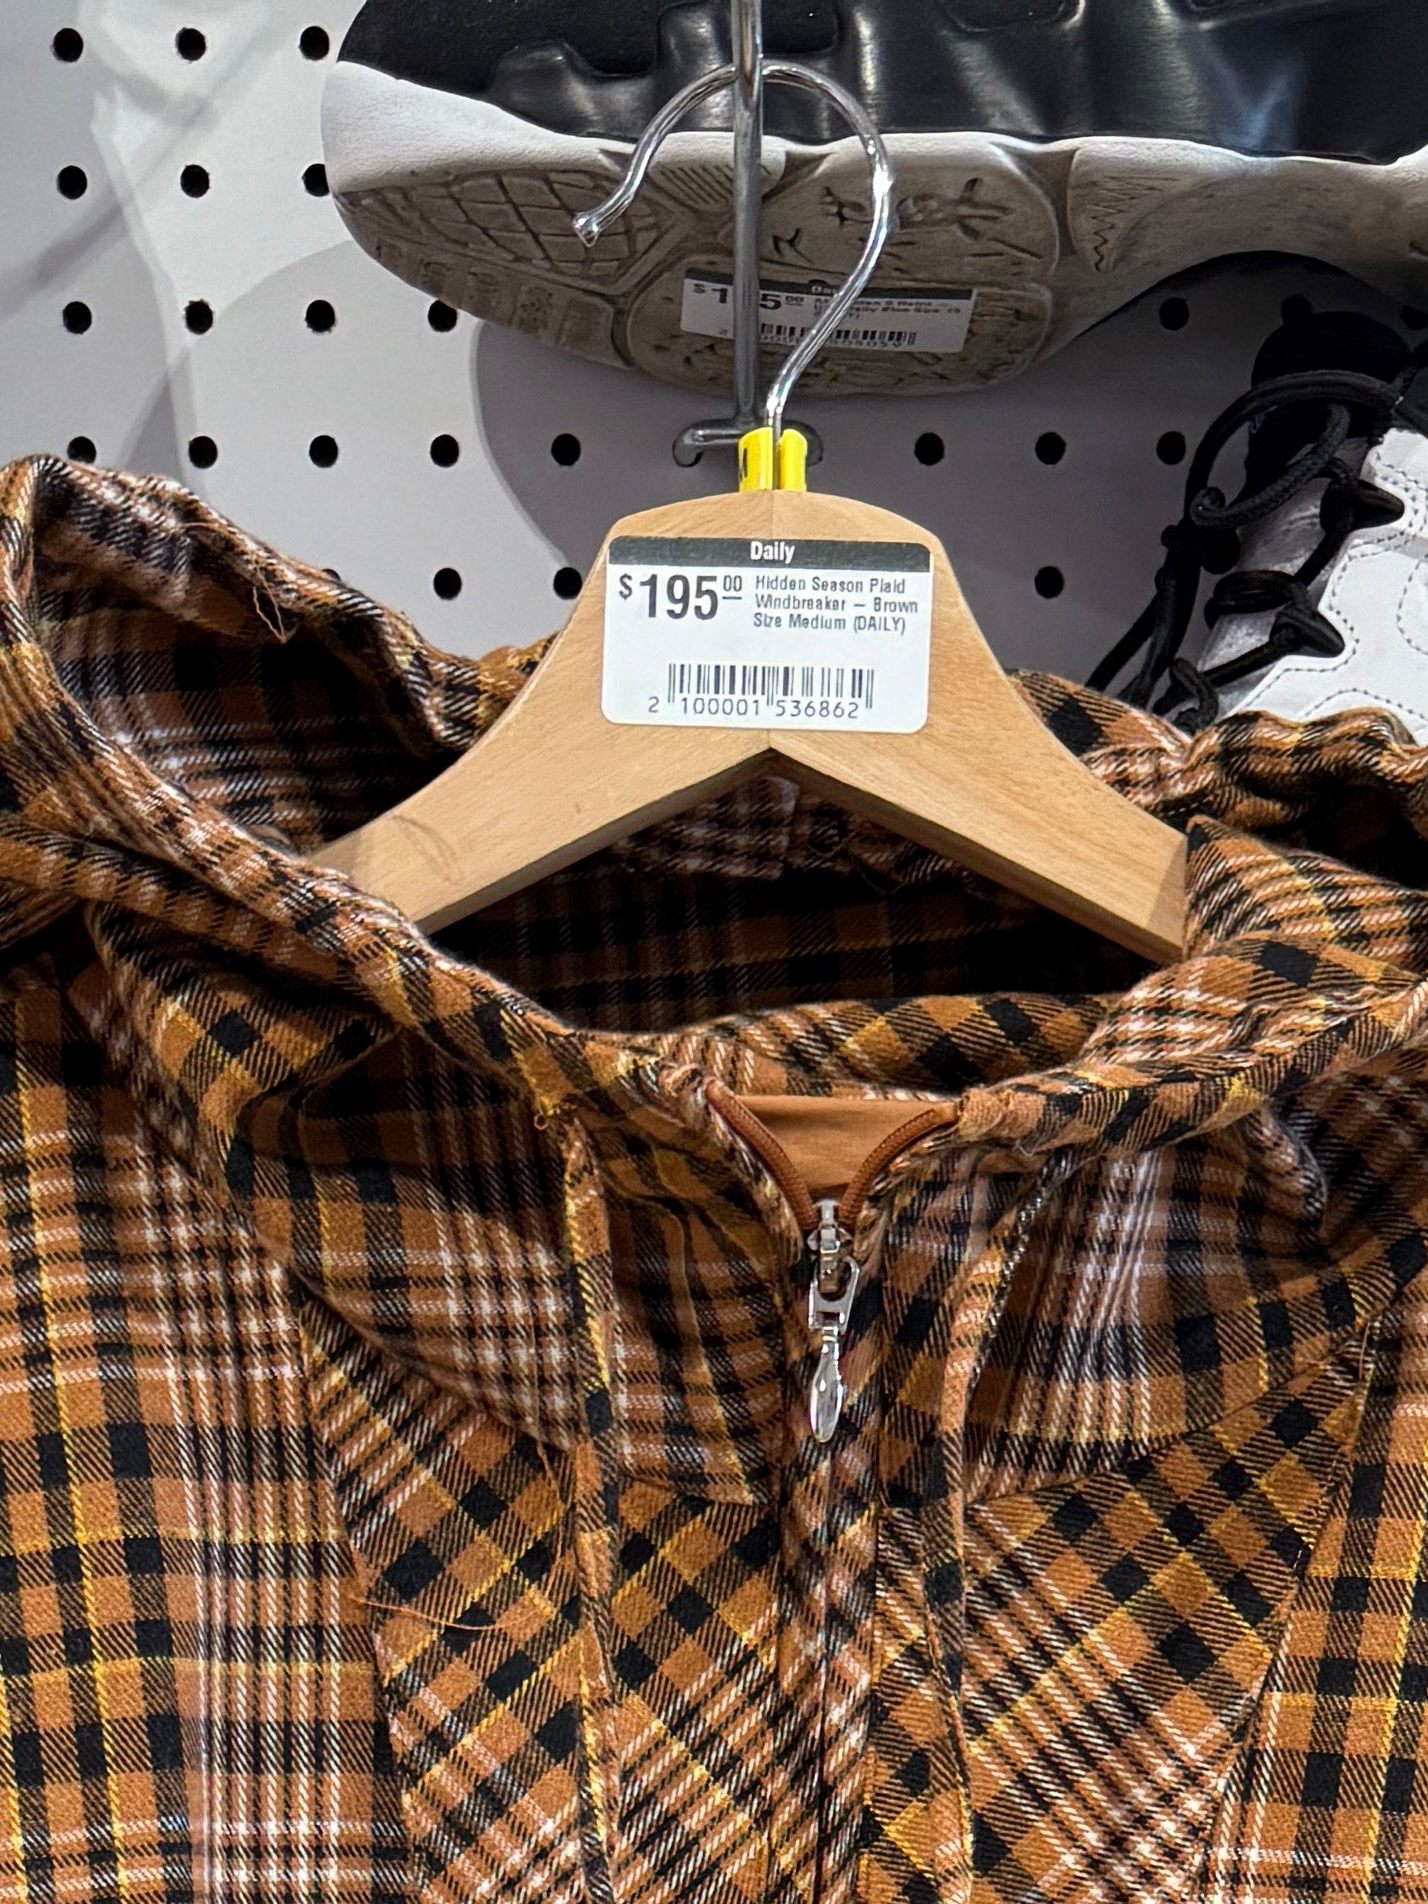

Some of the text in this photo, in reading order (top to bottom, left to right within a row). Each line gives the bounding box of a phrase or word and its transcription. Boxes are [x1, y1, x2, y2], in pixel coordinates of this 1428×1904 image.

[693, 283, 782, 311] $15
[750, 541, 796, 564] Daily
[755, 575, 906, 594] Hidden Season Plaid
[754, 594, 846, 612] Windbreaker
[873, 597, 919, 613] Brown
[753, 612, 906, 635] Size Medium (DAILY)
[648, 696, 860, 719] 2 100001 536862
